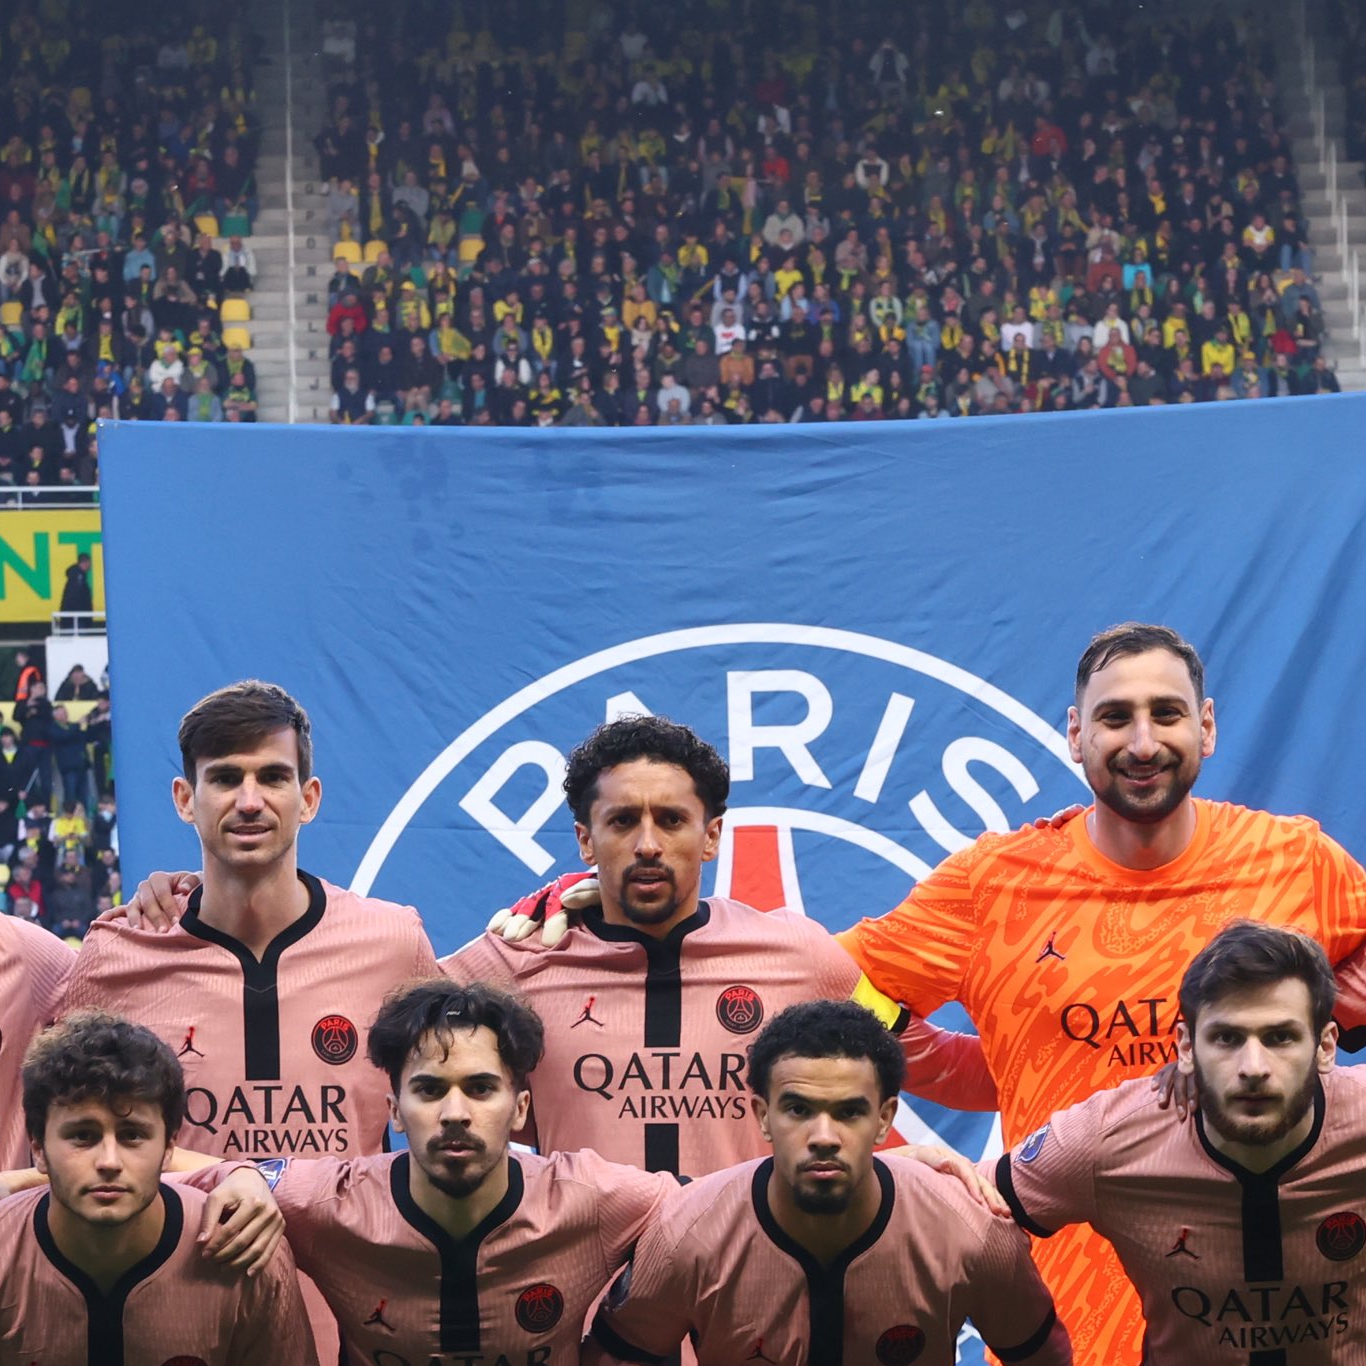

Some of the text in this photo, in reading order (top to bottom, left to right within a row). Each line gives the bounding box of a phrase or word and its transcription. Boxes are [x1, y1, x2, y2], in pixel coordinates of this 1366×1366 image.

[320, 1018, 351, 1031] PARIS
[1107, 1041, 1180, 1067] AIRW
[573, 1052, 746, 1101] QATAR
[184, 1085, 348, 1134] QATAR
[618, 1095, 746, 1119] AIRWAYS
[223, 1129, 348, 1154] AIRWAYS
[1172, 1280, 1349, 1327] QATAR
[1218, 1312, 1349, 1348] AIRWAYS
